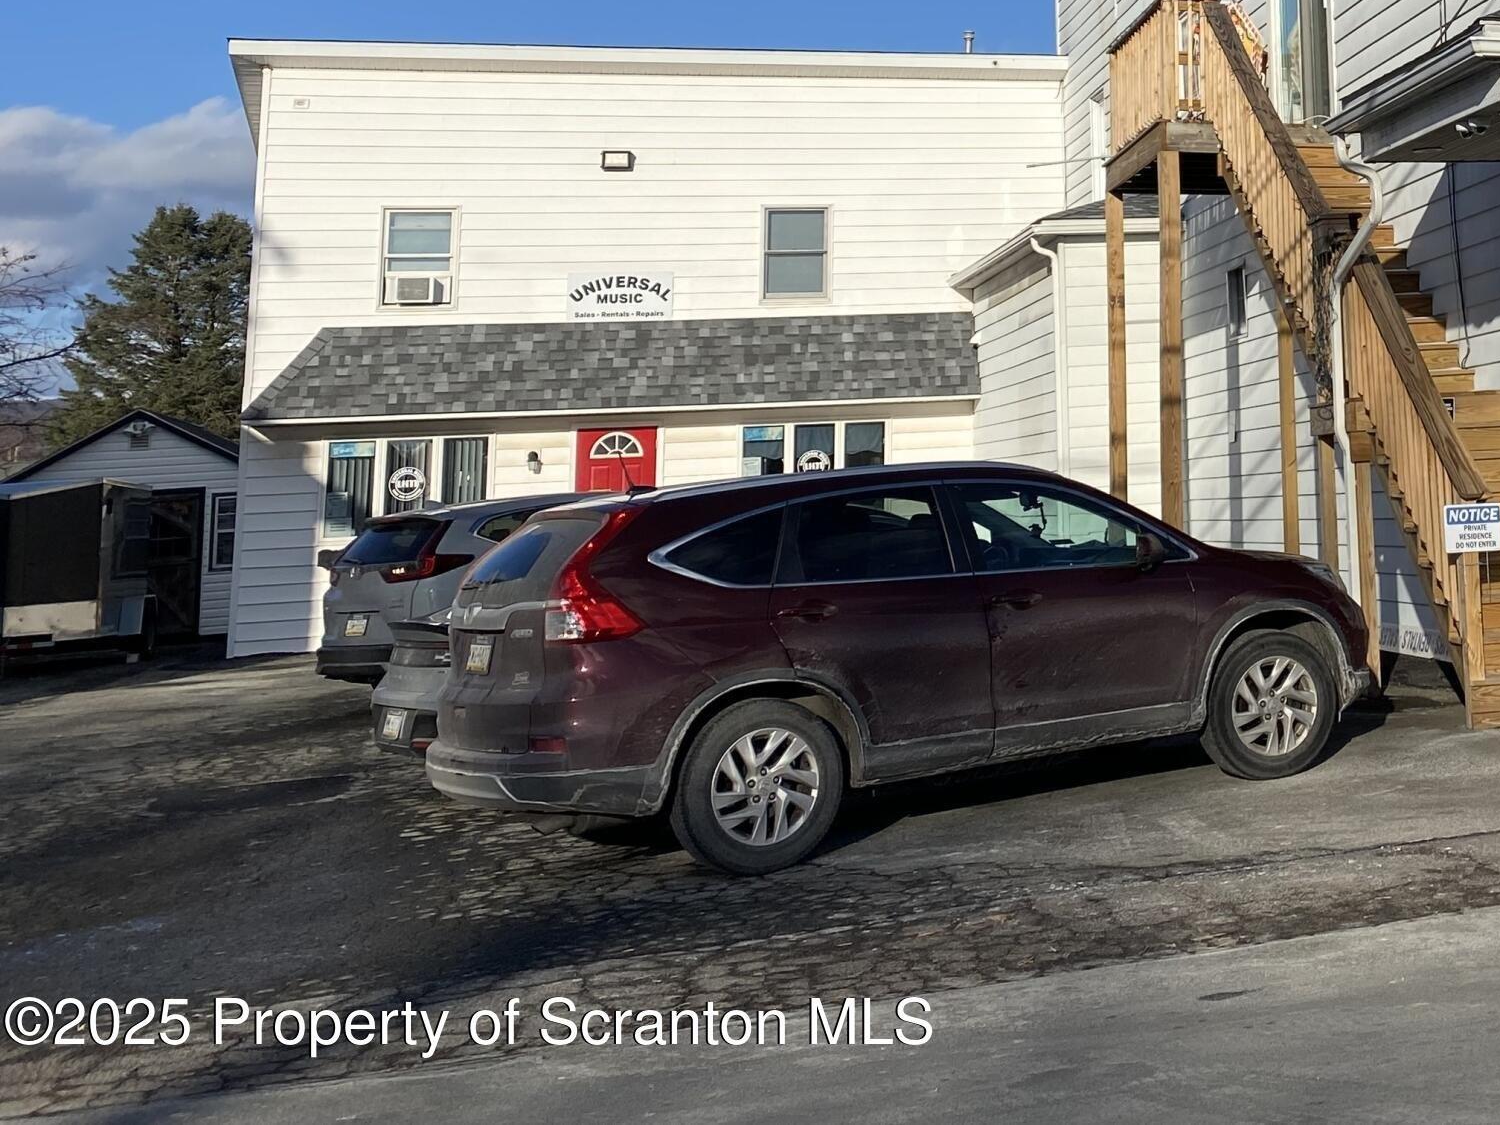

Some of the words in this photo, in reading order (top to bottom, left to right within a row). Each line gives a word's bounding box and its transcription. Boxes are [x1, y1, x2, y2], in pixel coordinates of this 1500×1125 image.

[569, 276, 671, 302] UNIVERSAL
[596, 293, 644, 304] MUSIC
[1448, 507, 1498, 523] NOTICE
[1478, 540, 1496, 548] ENTER
